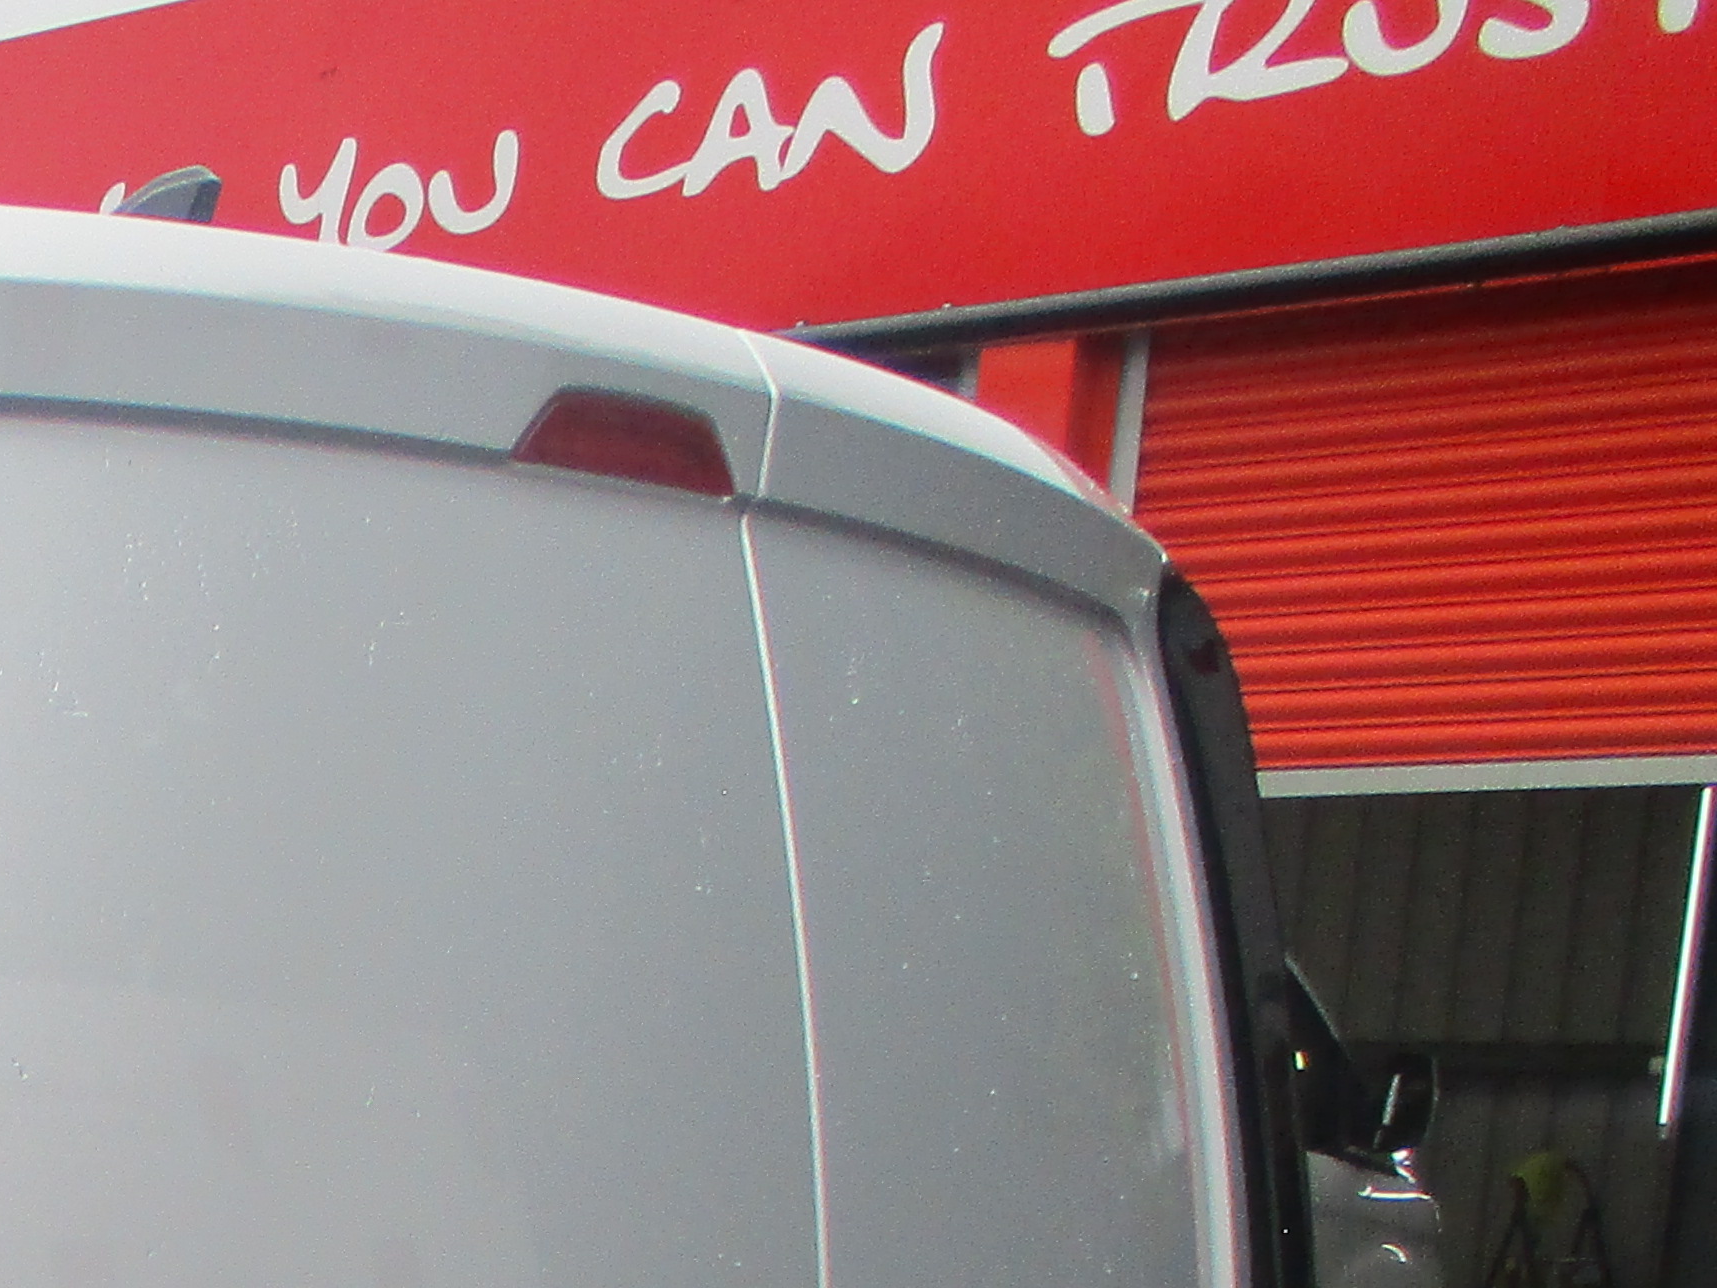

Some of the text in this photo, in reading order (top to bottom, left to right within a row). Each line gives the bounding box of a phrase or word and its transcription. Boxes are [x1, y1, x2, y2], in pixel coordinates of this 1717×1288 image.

[279, 0, 1698, 250] YOU CAN TRU
